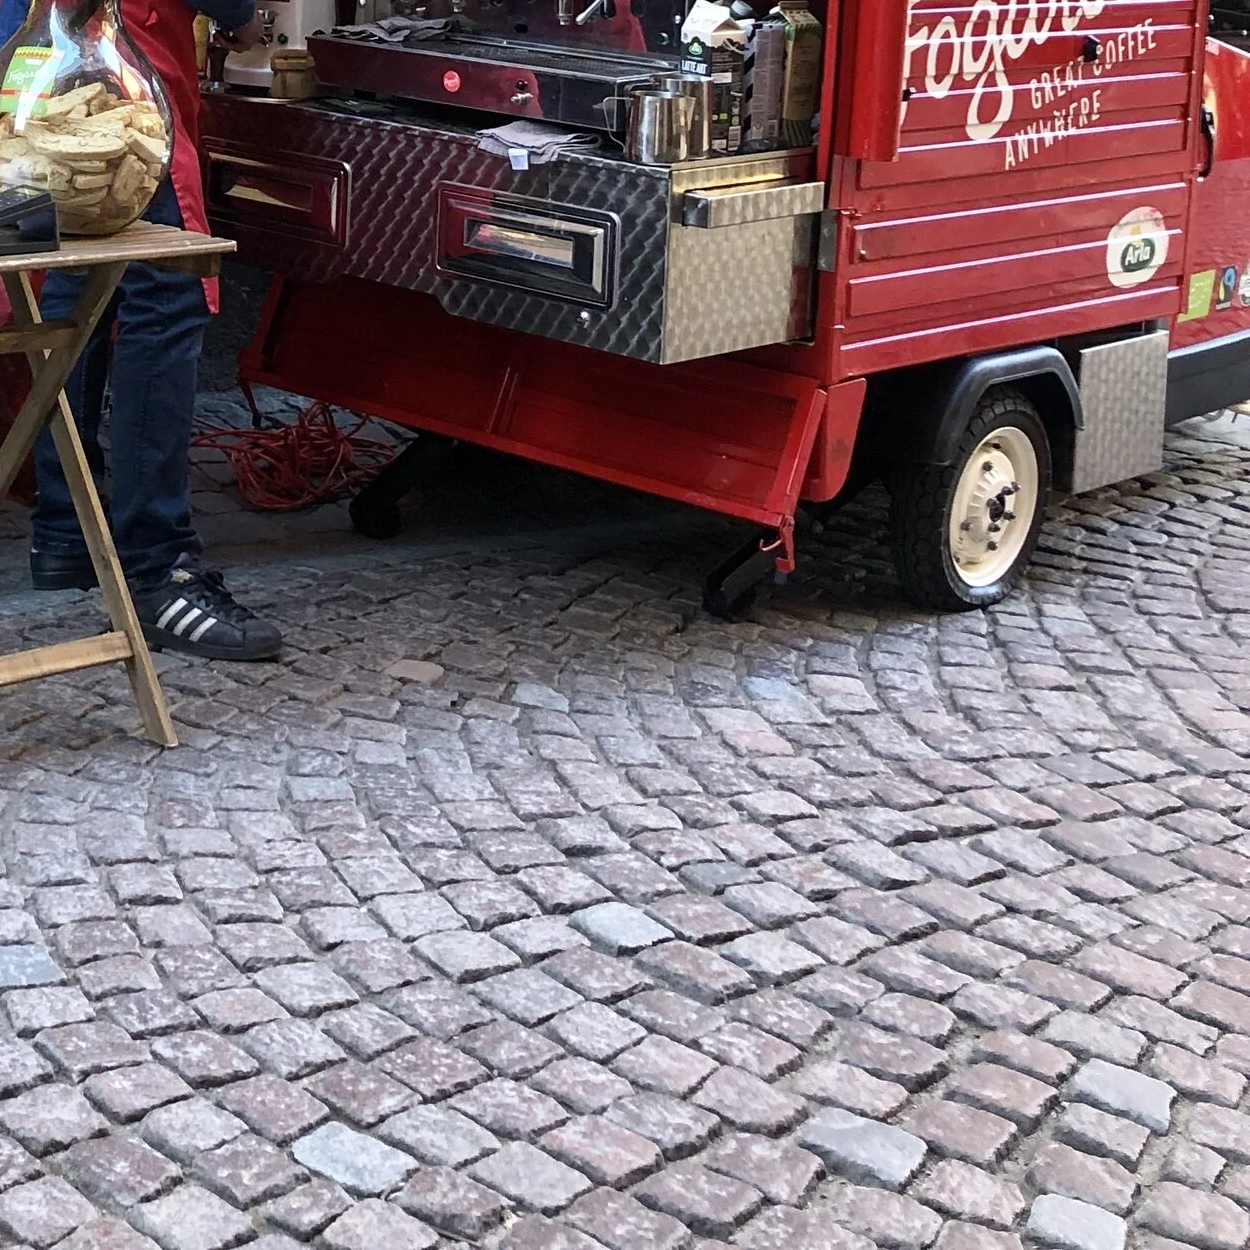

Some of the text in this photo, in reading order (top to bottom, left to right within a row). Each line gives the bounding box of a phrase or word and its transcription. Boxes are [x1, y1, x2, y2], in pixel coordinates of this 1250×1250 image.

[1030, 18, 1158, 110] GREAT COFFEE
[1005, 89, 1102, 171] ANYWHERE
[1124, 241, 1152, 266] Arla
